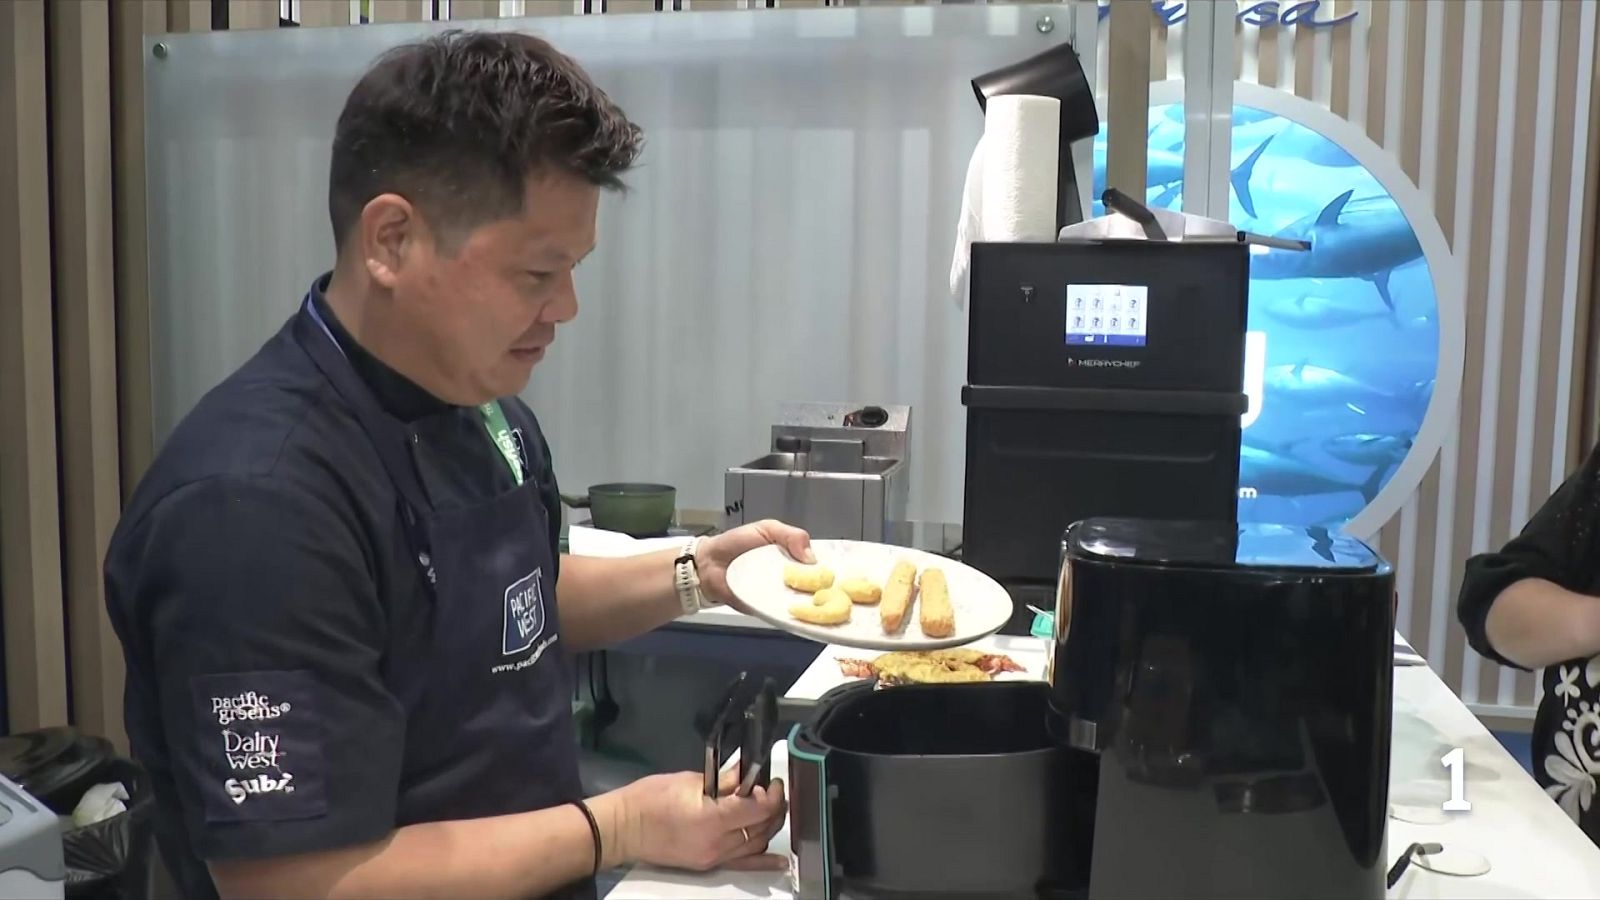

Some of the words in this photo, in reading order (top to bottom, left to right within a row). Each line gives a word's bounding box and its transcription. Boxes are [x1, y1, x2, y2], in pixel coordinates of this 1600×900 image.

[511, 584, 536, 617] PACIFIC
[517, 606, 537, 638] WEST
[211, 691, 269, 713] pacific
[221, 730, 279, 753] Dairy
[226, 752, 279, 769] West
